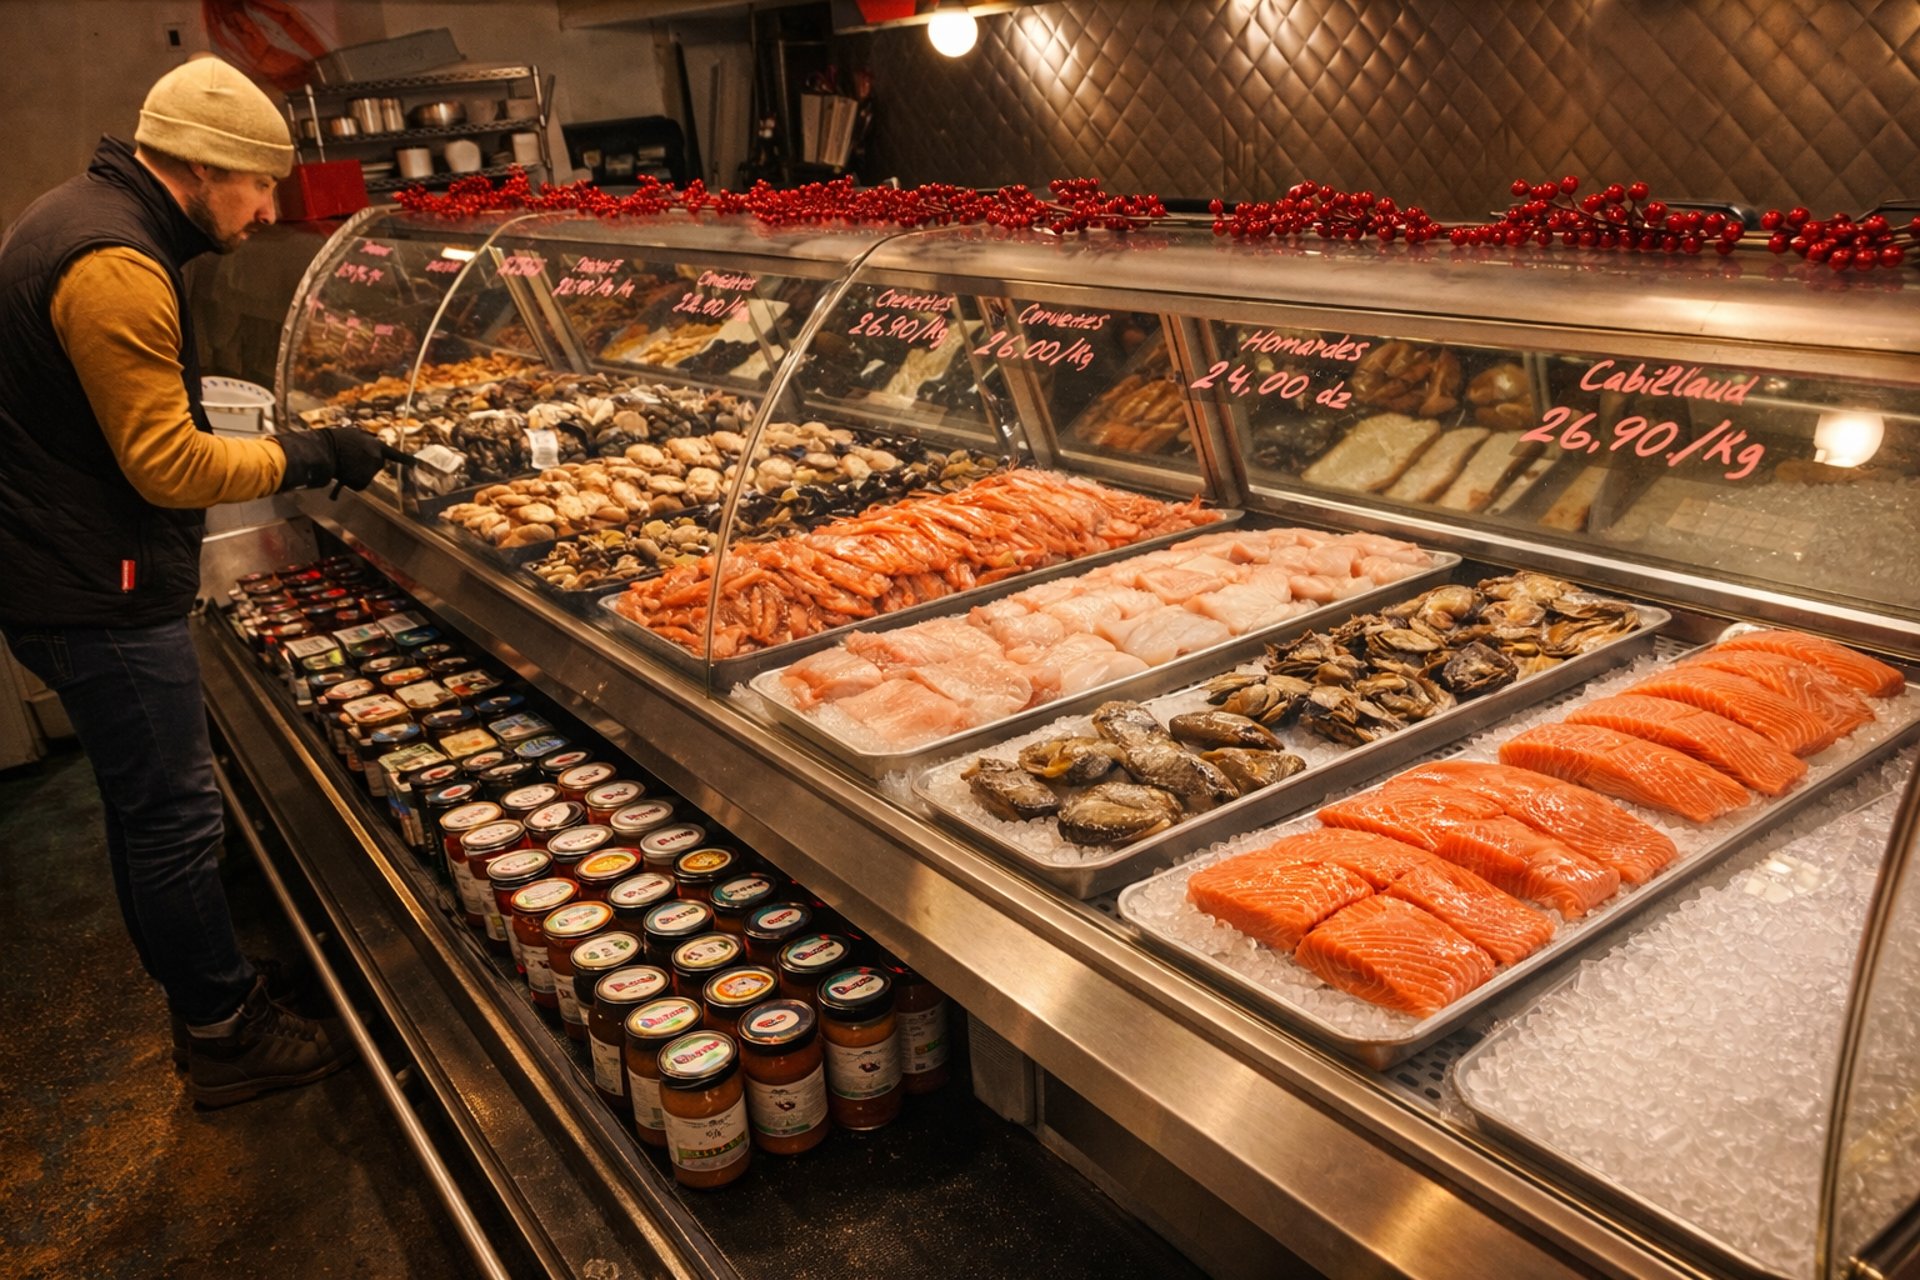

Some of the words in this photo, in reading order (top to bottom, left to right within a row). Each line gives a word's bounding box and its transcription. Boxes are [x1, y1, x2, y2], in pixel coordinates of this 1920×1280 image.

[973, 331, 1095, 372] 26,00/Kg
[1240, 329, 1371, 362] Homardes
[1190, 361, 1310, 399] 24,00
[1315, 381, 1352, 410] dz
[1580, 359, 1760, 405] Cabillaud
